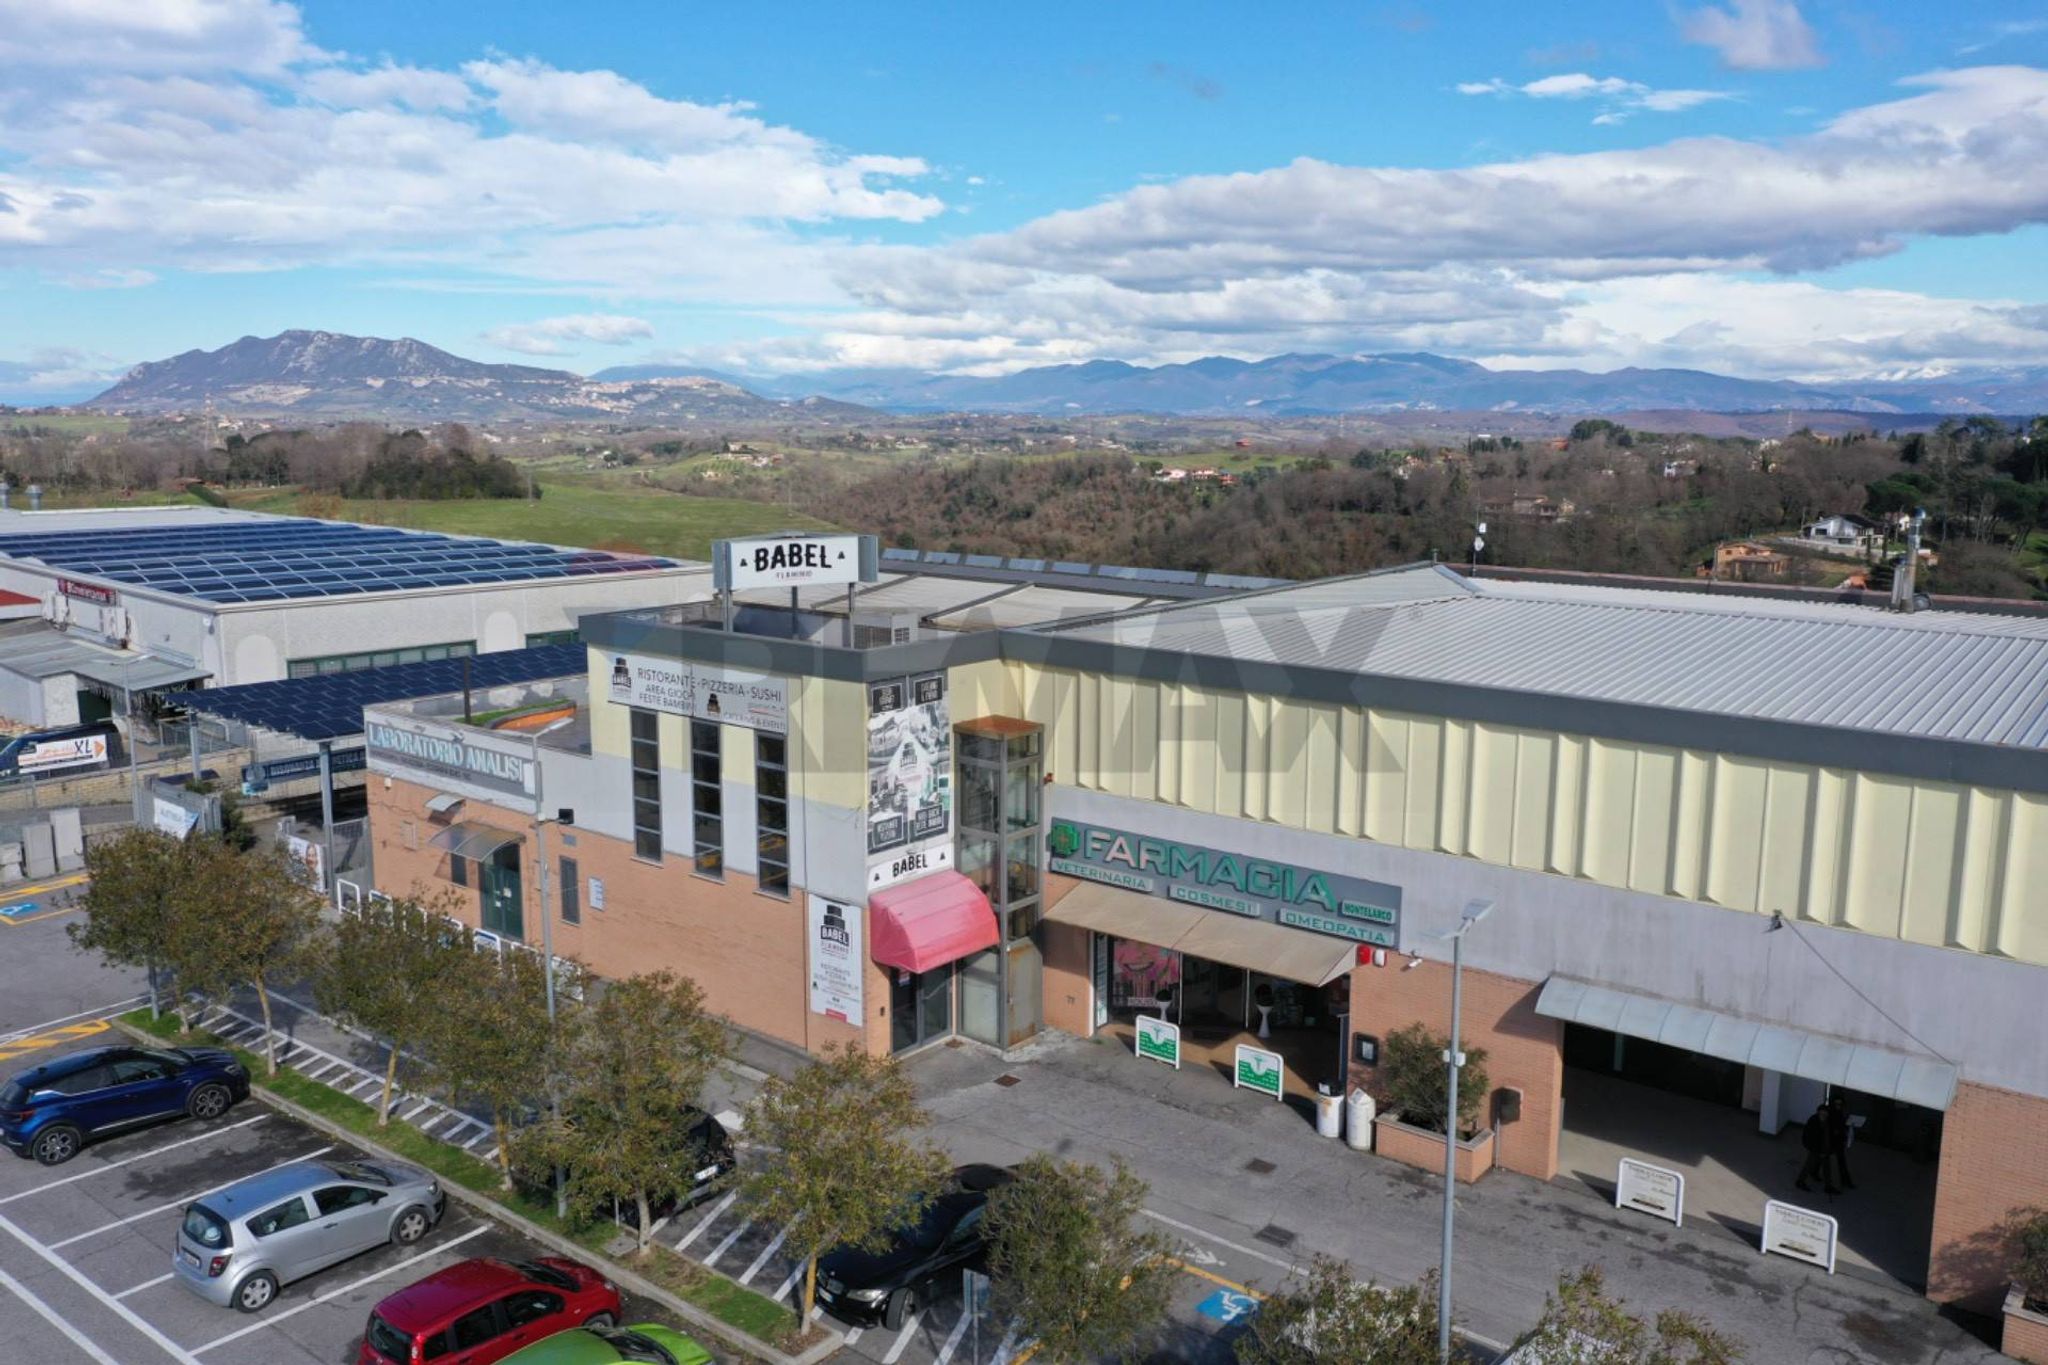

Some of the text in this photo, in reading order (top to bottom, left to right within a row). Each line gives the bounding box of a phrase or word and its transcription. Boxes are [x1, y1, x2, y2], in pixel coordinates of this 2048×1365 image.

[755, 543, 832, 572] BABEL
[638, 667, 782, 702] RISTORANTE PIZZERIA SUSHI
[644, 684, 666, 696] AREA
[639, 692, 662, 706] FESTE
[75, 738, 92, 754] XL
[368, 723, 463, 767] LABORATORIO
[466, 746, 523, 782] ANALISI
[892, 854, 928, 877] BABEL
[1055, 861, 1148, 890] VETERINARIA
[1083, 829, 1339, 913] FARMACIA
[1176, 887, 1253, 914] COSMESI
[821, 926, 849, 945] BABEL
[1284, 912, 1387, 944] OMEOPATIA
